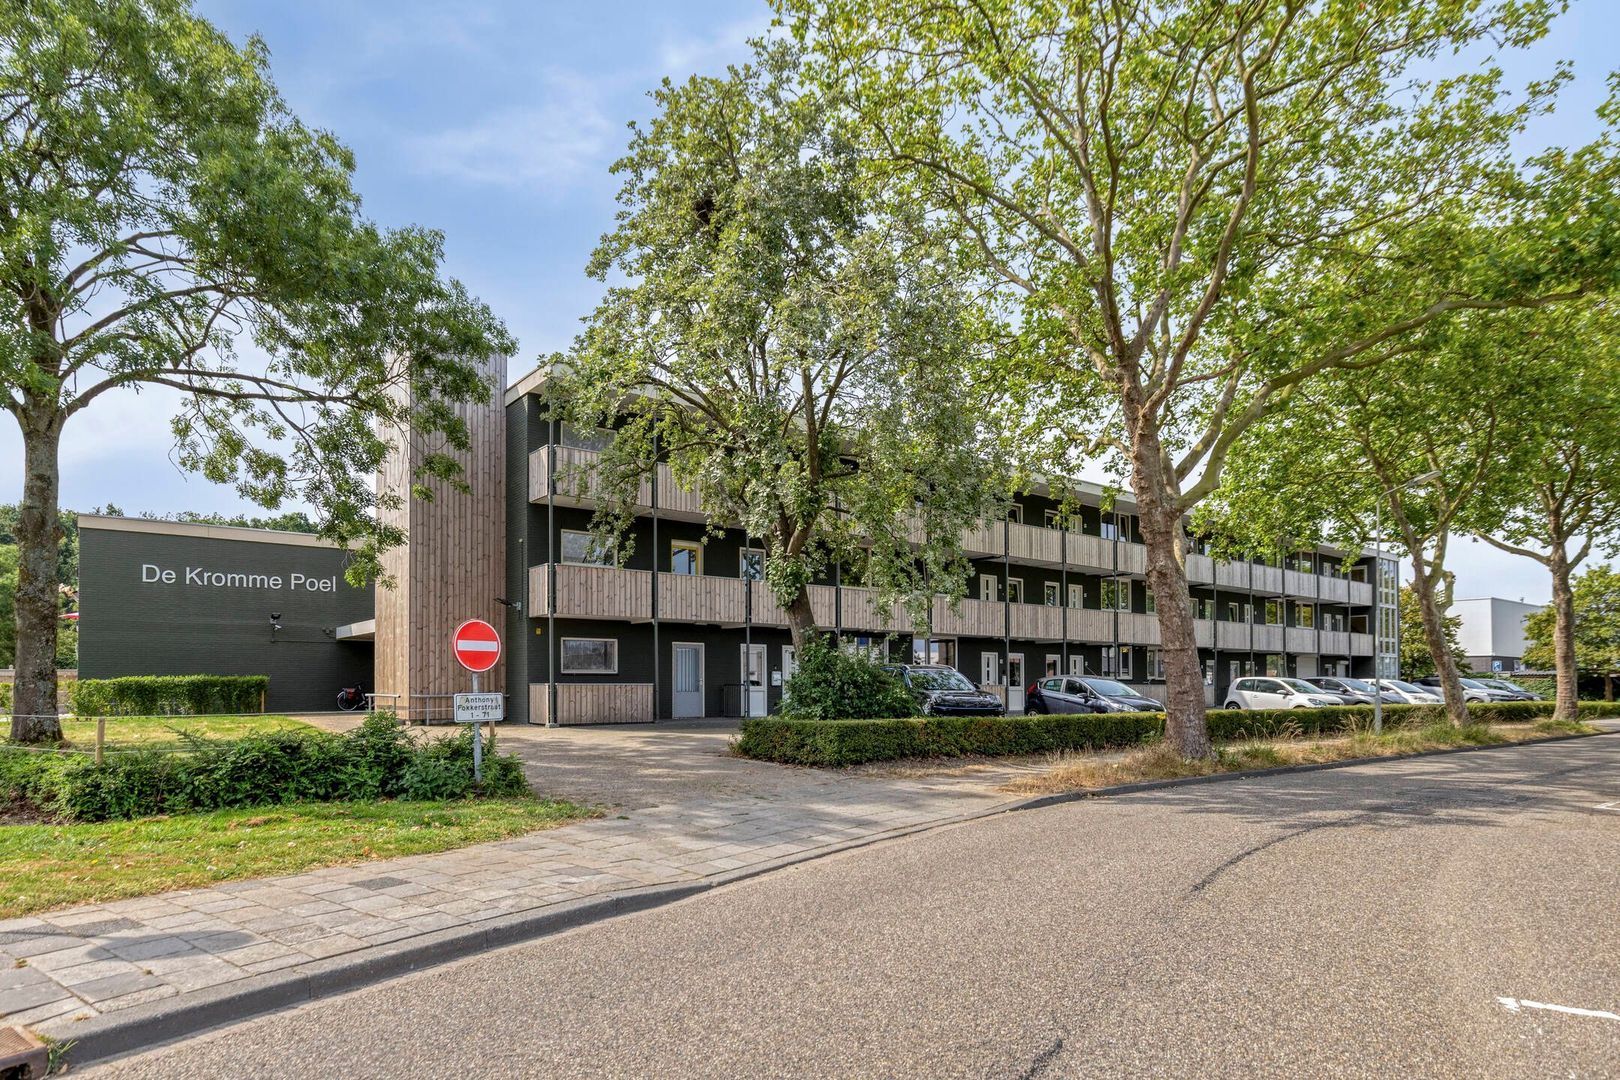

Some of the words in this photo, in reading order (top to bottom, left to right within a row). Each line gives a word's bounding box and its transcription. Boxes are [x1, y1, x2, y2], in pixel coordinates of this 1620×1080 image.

[142, 564, 176, 584] De
[185, 567, 282, 589] Kromme
[290, 573, 336, 592] Poel
